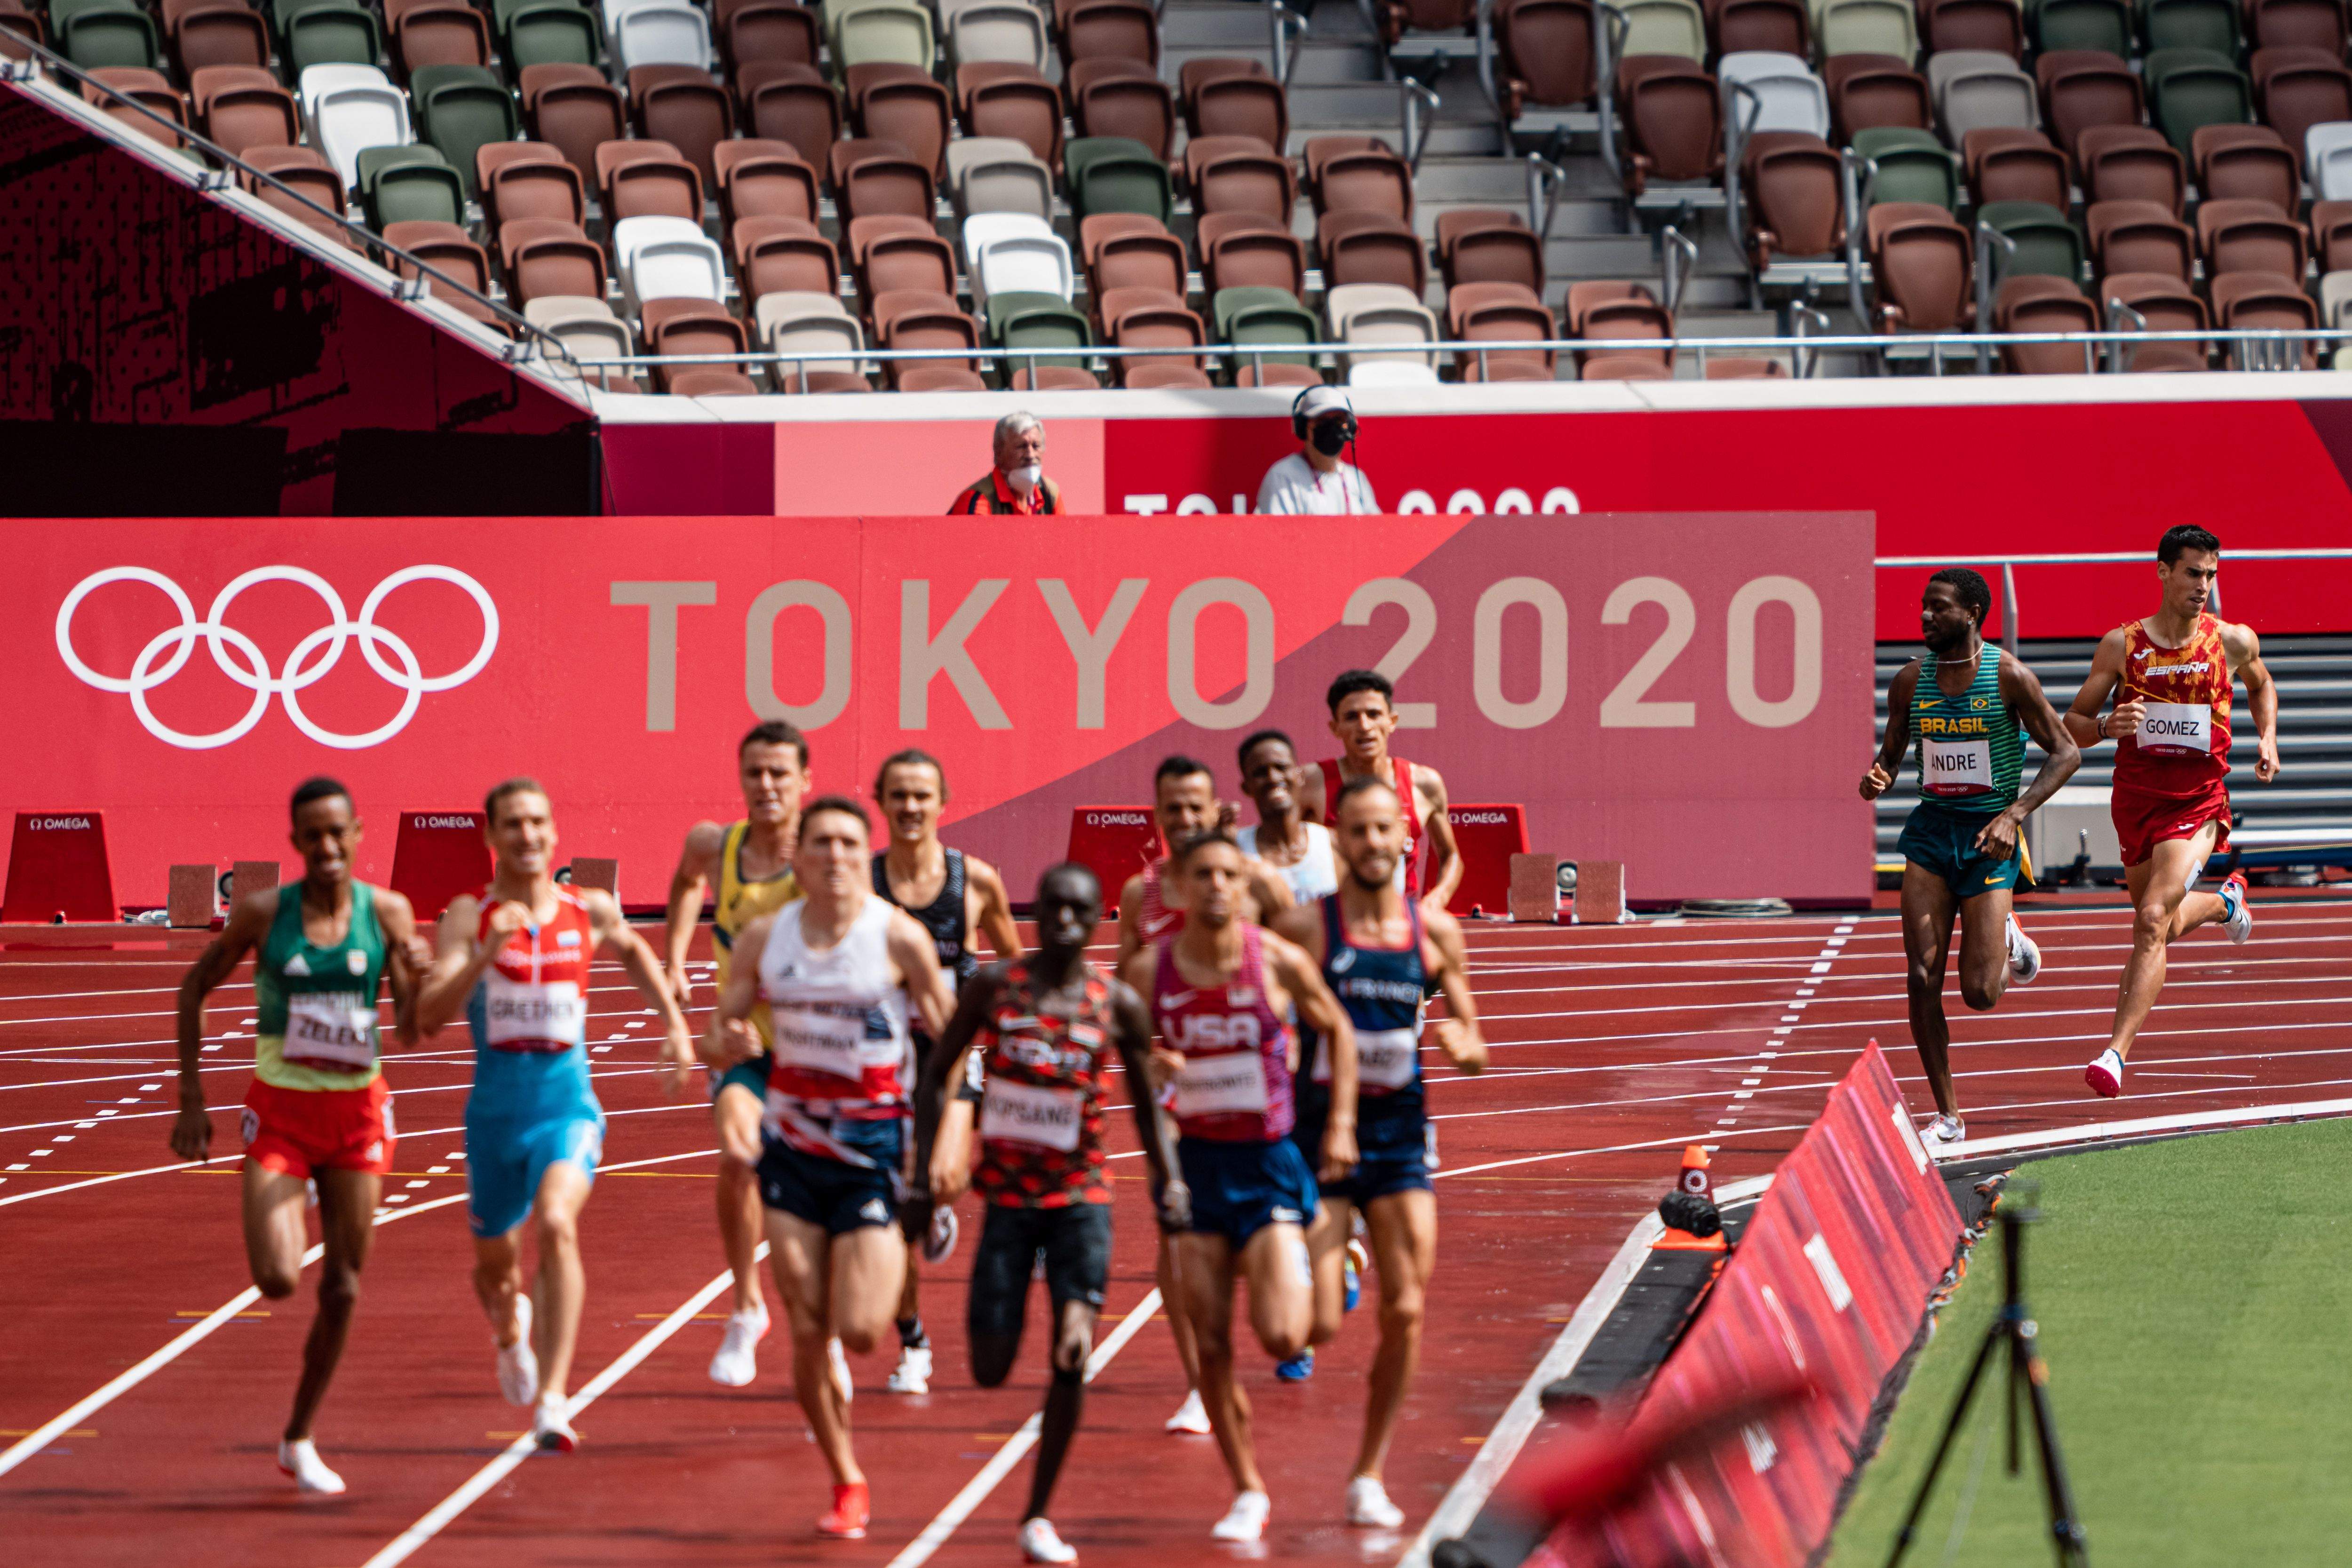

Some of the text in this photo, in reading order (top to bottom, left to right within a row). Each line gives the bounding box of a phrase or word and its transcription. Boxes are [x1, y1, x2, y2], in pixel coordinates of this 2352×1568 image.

[610, 575, 1823, 732] TOKYO 2020
[1920, 717, 1988, 733] BRASIL
[2146, 719, 2199, 736] GOMEZ
[1931, 753, 1977, 772] ANDRE
[44, 818, 90, 830] OMEGA
[429, 816, 475, 828] OMEGA
[1101, 813, 1147, 825] OMEGA
[1462, 812, 1508, 823] OMEGA
[1160, 1013, 1260, 1051] USA
